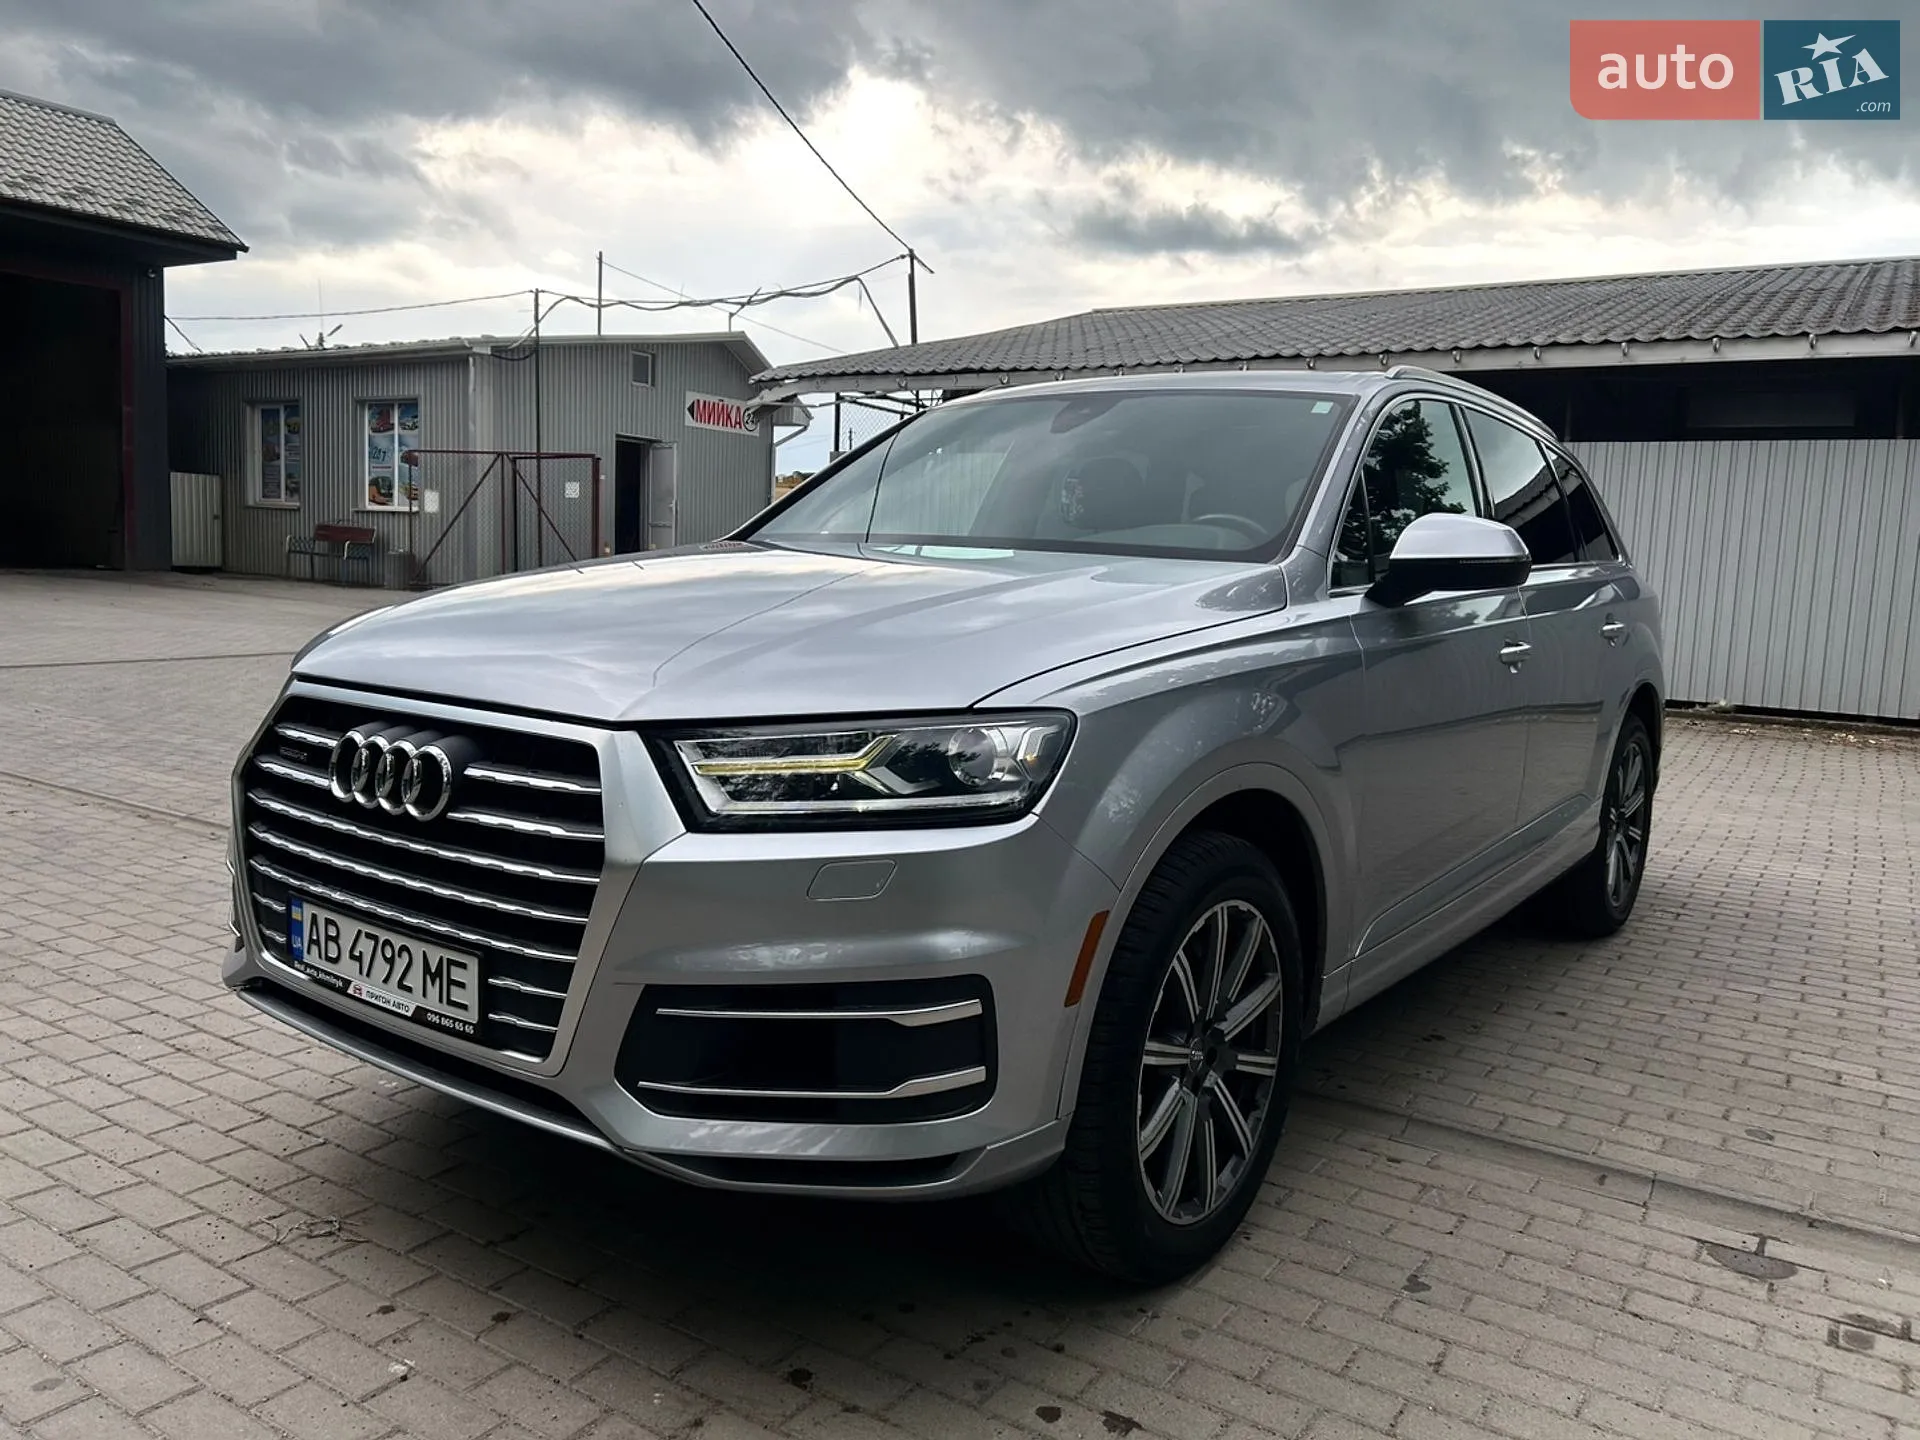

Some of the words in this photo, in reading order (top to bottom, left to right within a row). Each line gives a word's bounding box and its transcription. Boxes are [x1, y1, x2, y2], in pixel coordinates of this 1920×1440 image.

[695, 398, 742, 430] МИЙКА
[306, 911, 342, 965] AB
[348, 928, 414, 994] 4792
[422, 949, 469, 1012] ME
[365, 990, 391, 1005] ПРИГОН
[392, 1000, 410, 1013] АВТО
